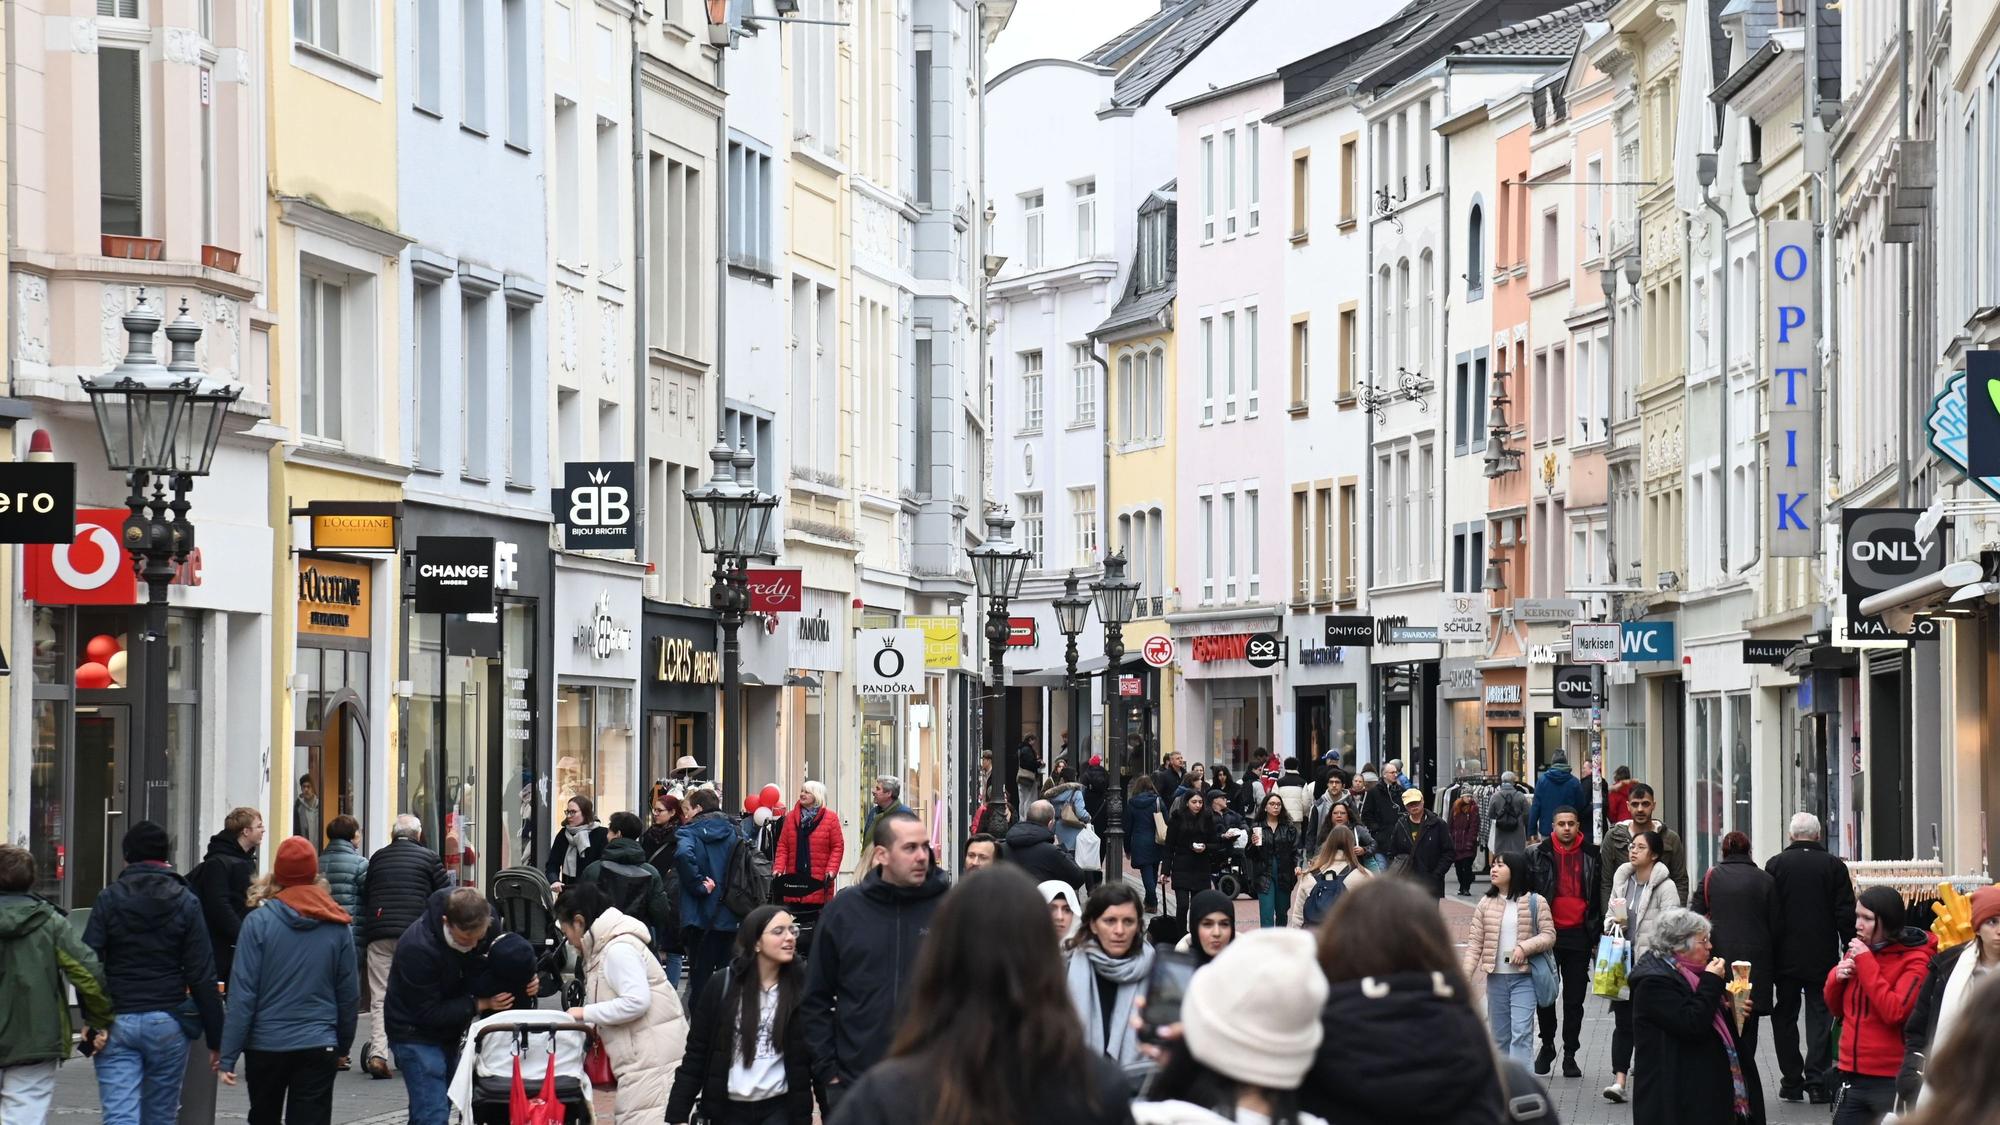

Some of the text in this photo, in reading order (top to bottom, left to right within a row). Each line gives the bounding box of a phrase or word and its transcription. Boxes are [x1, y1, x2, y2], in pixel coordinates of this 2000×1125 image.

[1774, 244, 1811, 531] OPTIK
[571, 527, 628, 536] BIJOU BRIGITTE
[1852, 541, 1935, 562] ONLY
[419, 564, 489, 578] CHANGE
[746, 577, 796, 605] redy
[1524, 608, 1575, 618] KERSTING
[1444, 623, 1482, 632] SCHULZ
[1854, 621, 1934, 635] MAGO
[1621, 630, 1658, 653] WC
[1749, 647, 1791, 656] HALLHU
[658, 637, 692, 683] LORIS
